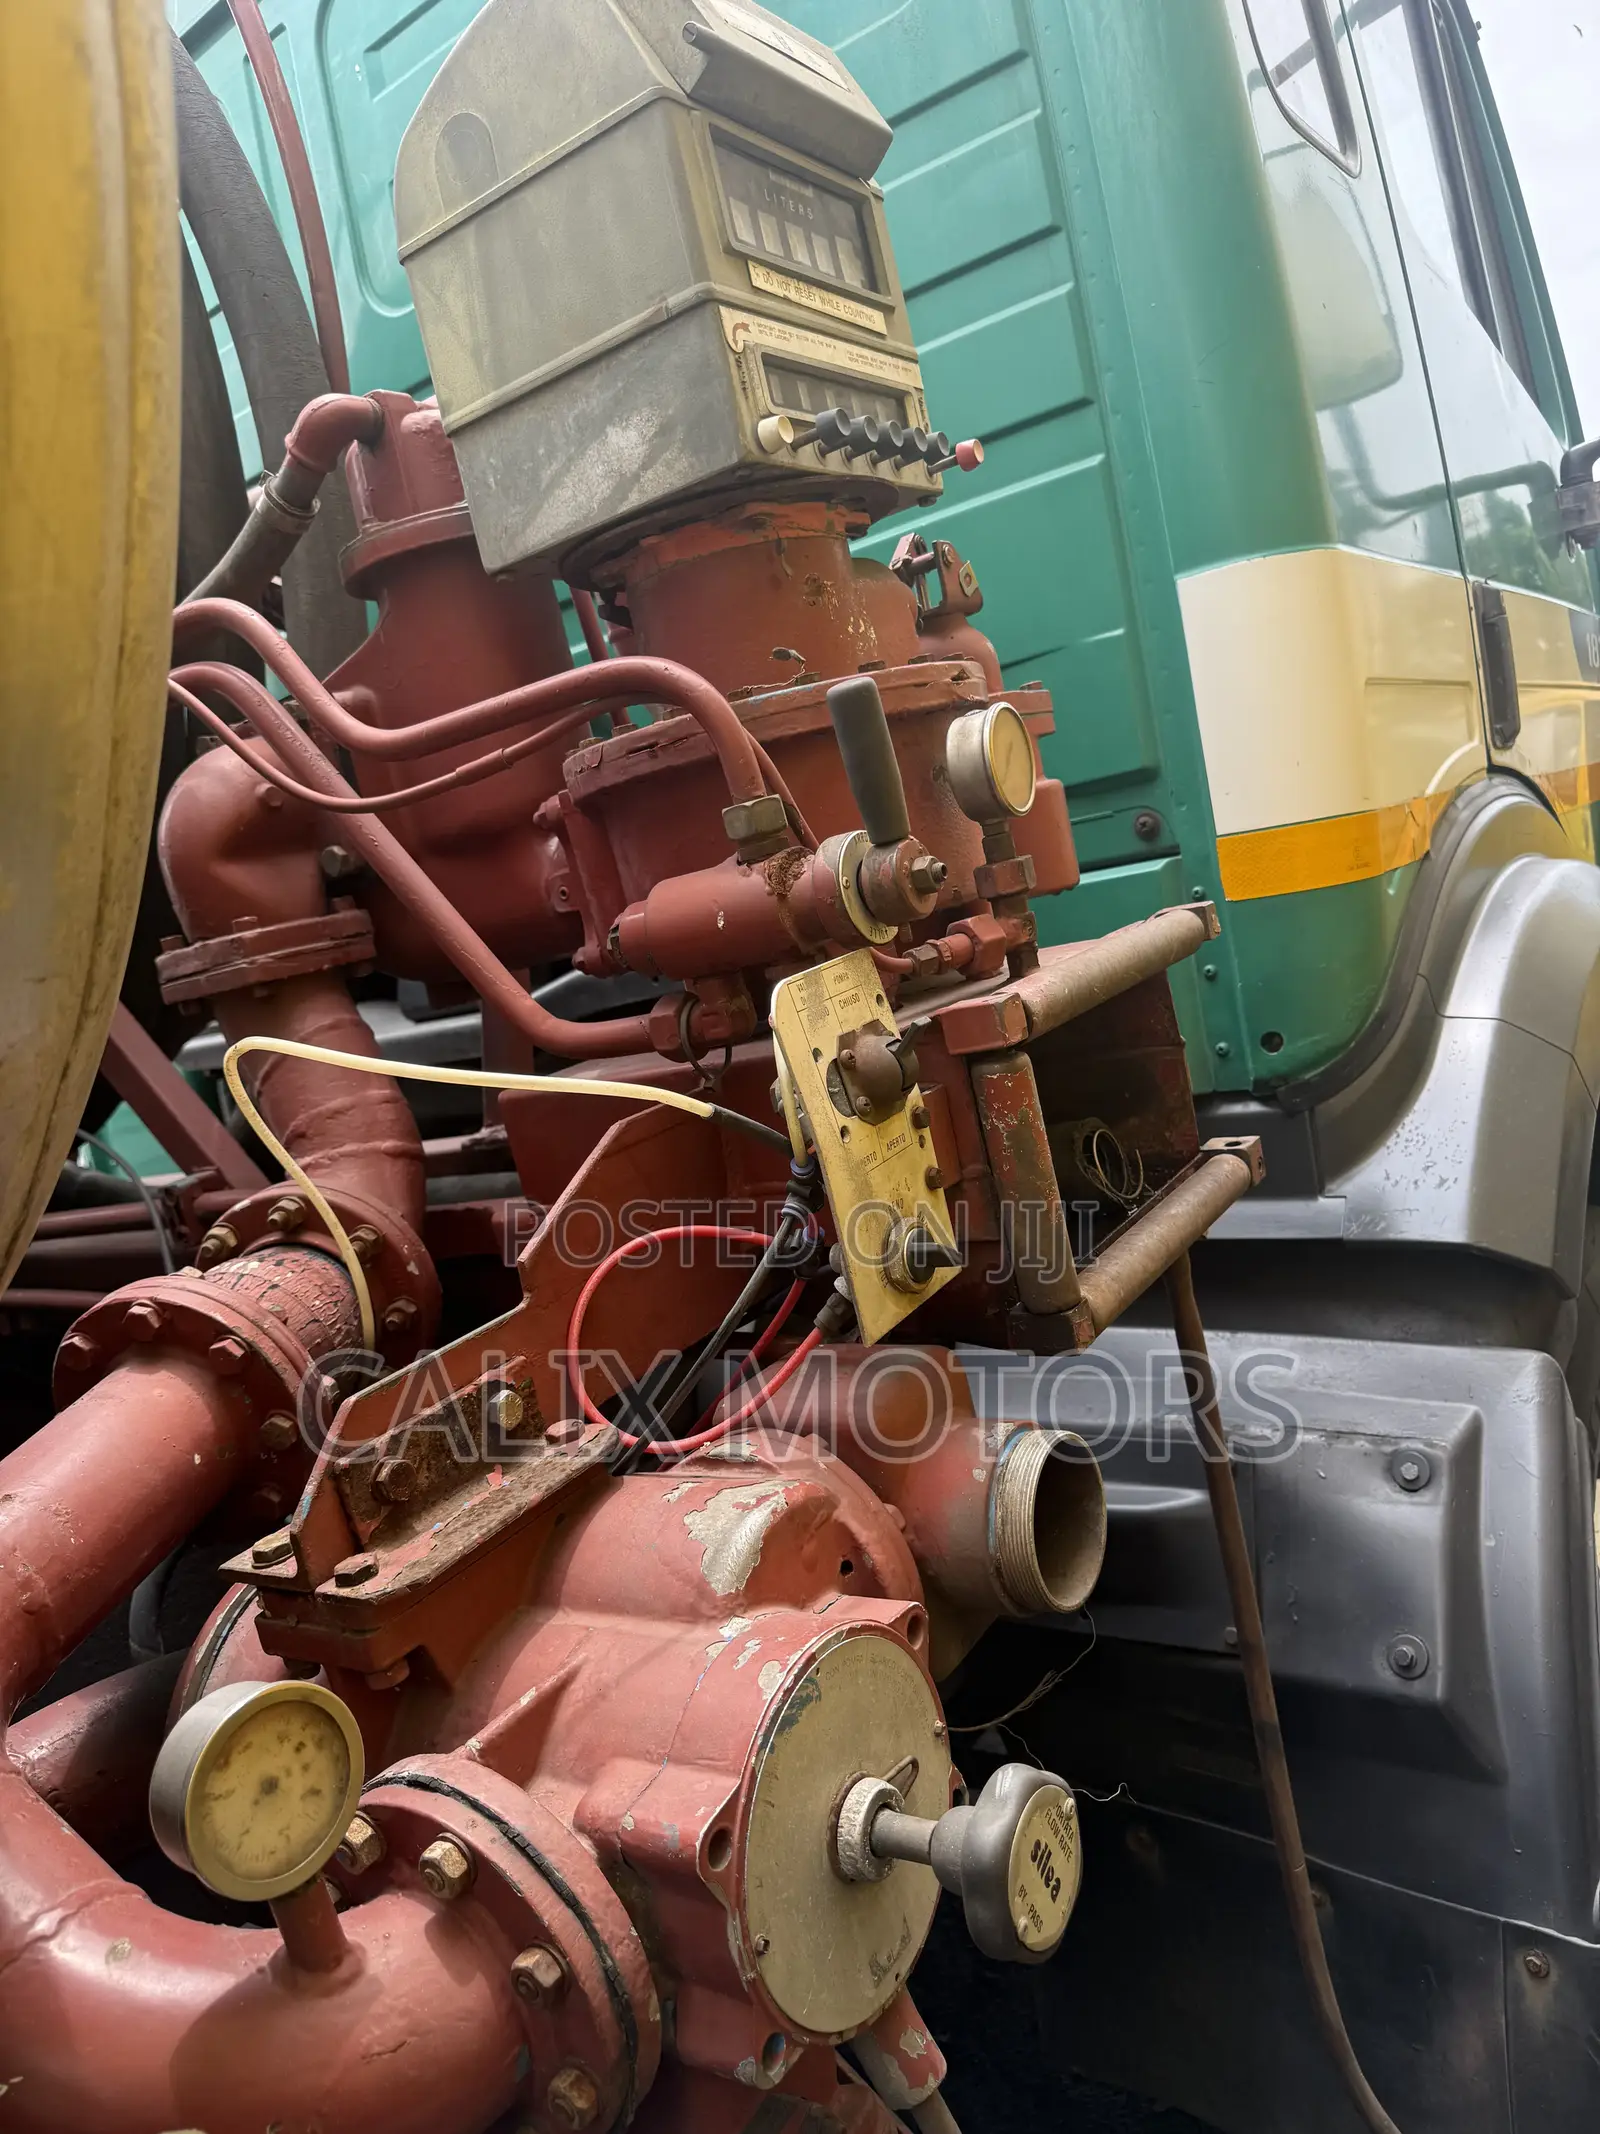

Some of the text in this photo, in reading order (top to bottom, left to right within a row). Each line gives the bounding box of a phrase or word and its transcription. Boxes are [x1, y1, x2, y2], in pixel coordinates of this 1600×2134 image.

[764, 188, 814, 220] LITERS
[763, 272, 876, 325] DO NOT RESET WHILE COUNTING
[1586, 632, 1600, 668] 18
[838, 992, 861, 1010] CHIUSO
[886, 1132, 906, 1152] APERTO
[1044, 1807, 1074, 1863] FLOW RATE
[1030, 1838, 1061, 1904] silea
[1018, 1884, 1028, 1902] BY
[1027, 1903, 1044, 1934] PASS
